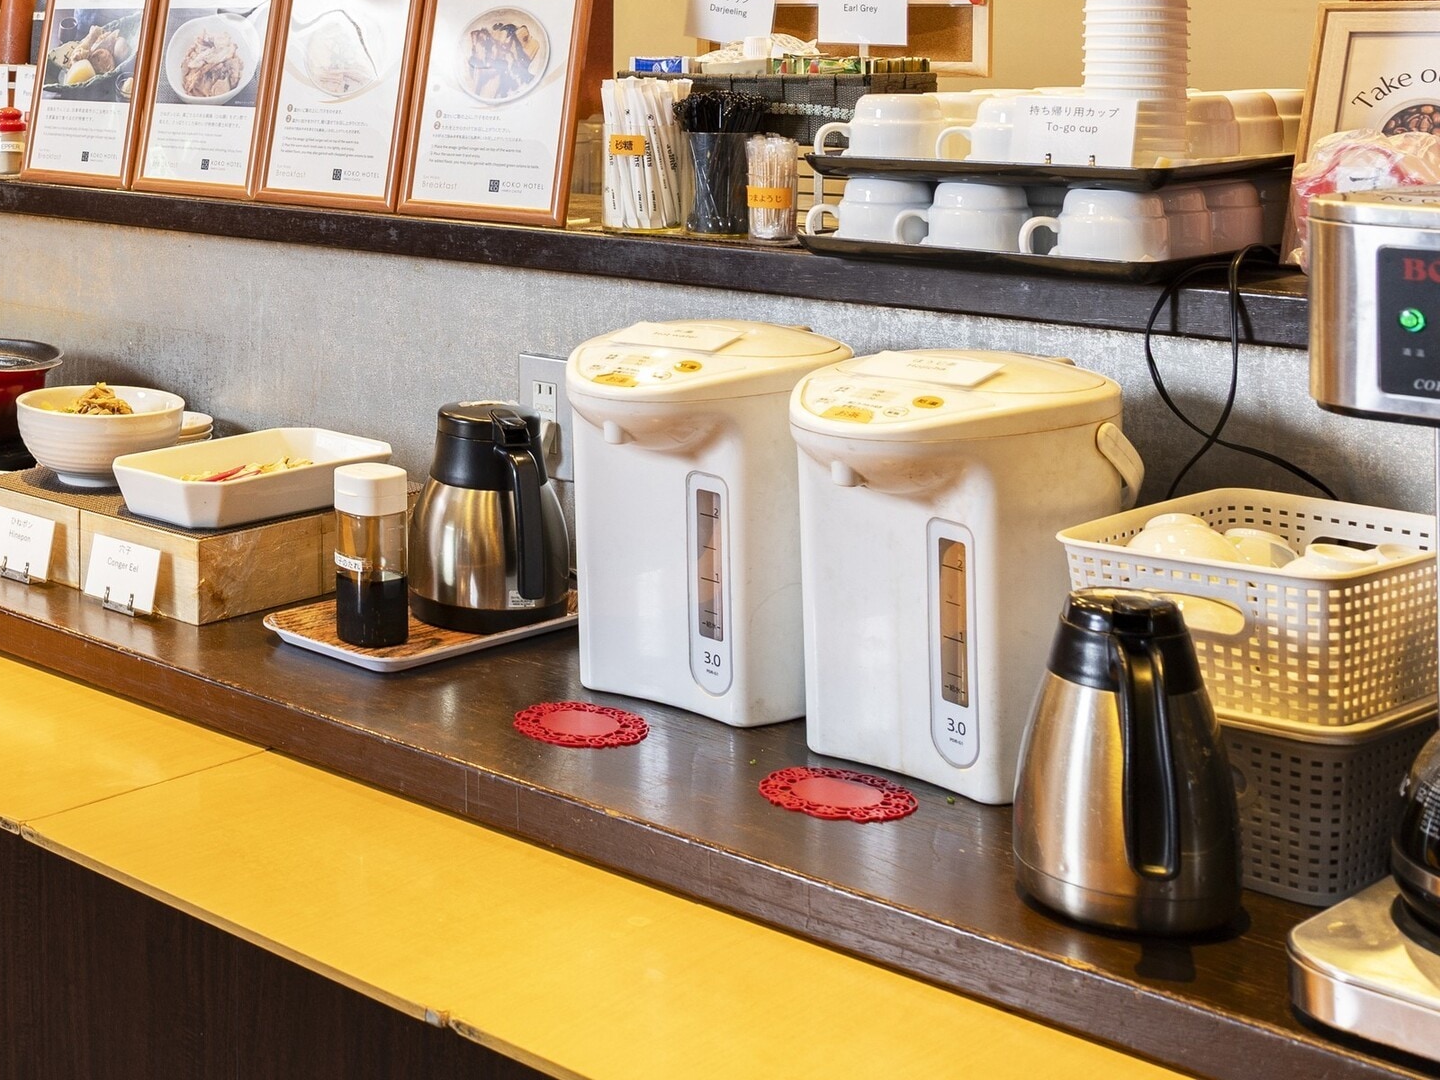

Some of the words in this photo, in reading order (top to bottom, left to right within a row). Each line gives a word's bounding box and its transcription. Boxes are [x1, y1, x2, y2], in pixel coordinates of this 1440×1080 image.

[709, 3, 747, 18] Darjeeling
[843, 3, 858, 12] Earl
[860, 3, 878, 15] Grey
[1351, 72, 1413, 108] Take
[1420, 68, 1440, 84] o
[1029, 104, 1120, 118] 持ち帰り用カップ
[1046, 122, 1076, 134] To-go
[1079, 124, 1098, 135] cup
[615, 139, 633, 151] 砂糖
[275, 169, 306, 178] Breakfast
[421, 180, 458, 190] Breakfast
[523, 182, 544, 190] HOTEL
[713, 507, 719, 517] 2
[11, 517, 33, 529] ひねポン
[118, 544, 132, 555] 穴子
[108, 556, 128, 570] Conger
[129, 562, 139, 573] Eel
[957, 559, 963, 569] 2
[715, 572, 719, 581] 1
[959, 631, 963, 641] 1
[703, 651, 721, 667] 3.0
[947, 717, 966, 736] 3.0
